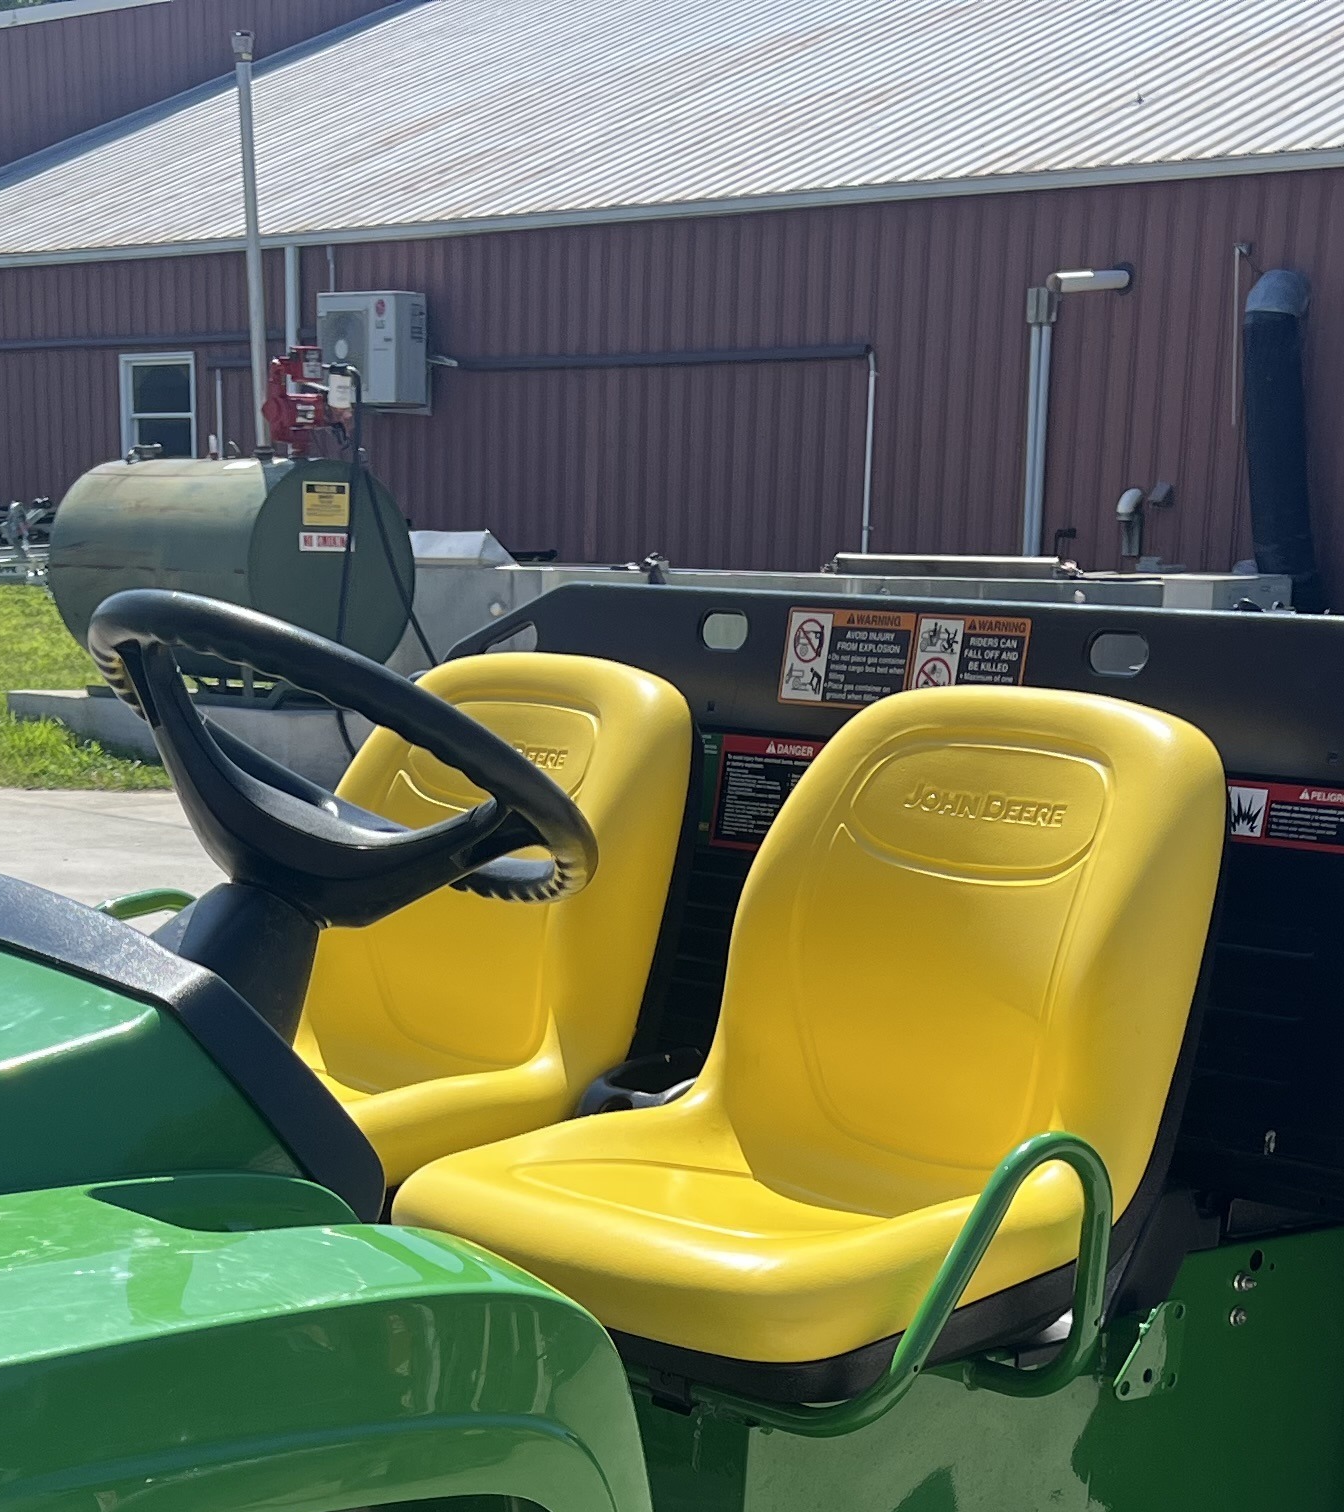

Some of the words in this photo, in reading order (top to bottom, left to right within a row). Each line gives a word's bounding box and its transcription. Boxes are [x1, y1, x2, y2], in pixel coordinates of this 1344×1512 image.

[857, 614, 901, 627] WARNING
[978, 620, 1027, 633] WARNING
[846, 630, 868, 640] AVOID
[869, 632, 896, 642] INJURY
[837, 642, 858, 651] FROM
[859, 643, 901, 654] EXPLOSION
[969, 637, 998, 648] RIDERS
[1000, 638, 1018, 649] CAN
[964, 649, 983, 659] FALL
[984, 650, 1000, 660] OFF
[1001, 651, 1019, 661] AND
[968, 661, 979, 671] BE
[980, 662, 1009, 673] KILLED
[777, 744, 814, 757] DANGER
[904, 781, 980, 819] JOHN
[981, 791, 1068, 828] DEERE
